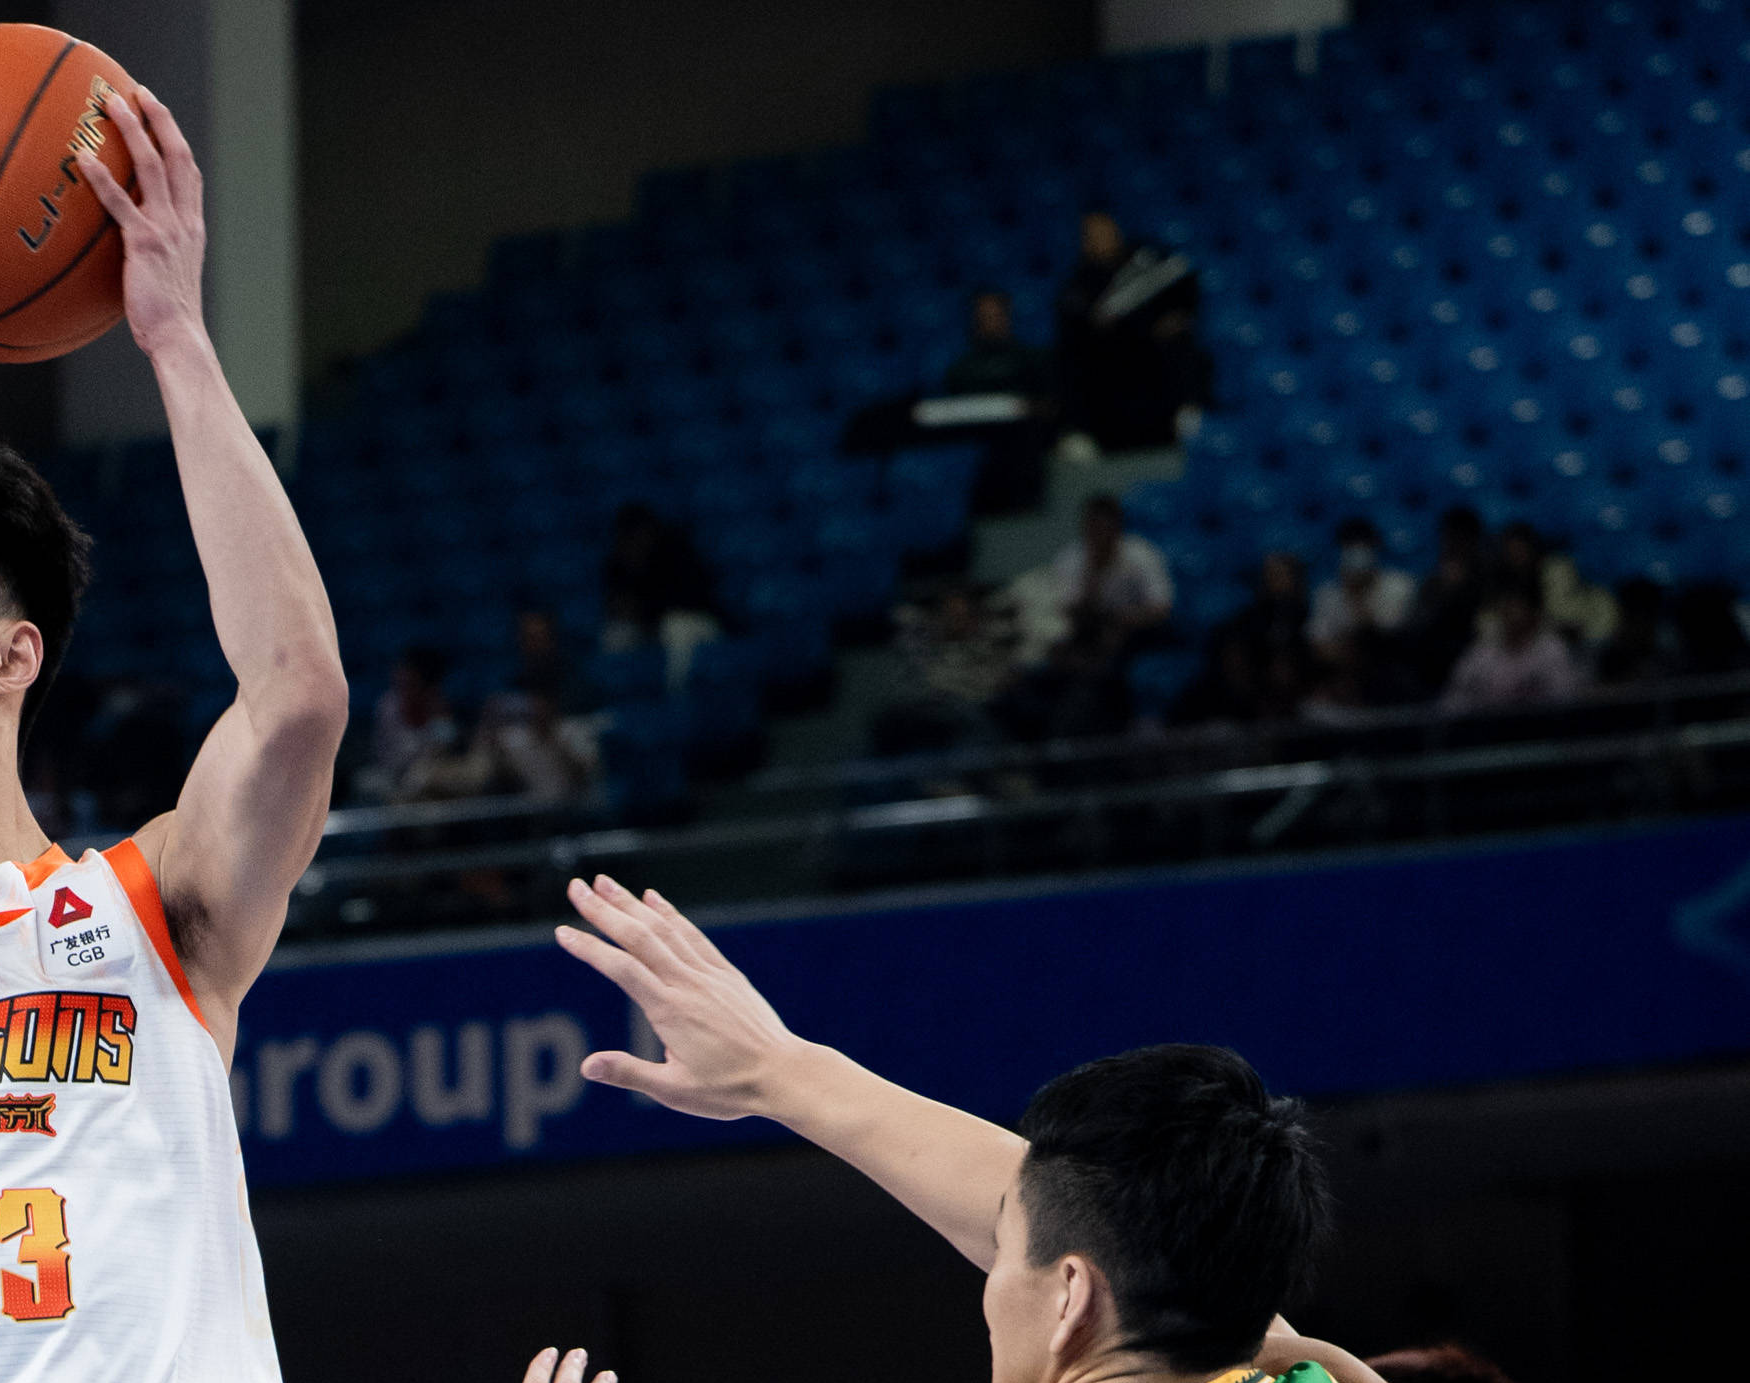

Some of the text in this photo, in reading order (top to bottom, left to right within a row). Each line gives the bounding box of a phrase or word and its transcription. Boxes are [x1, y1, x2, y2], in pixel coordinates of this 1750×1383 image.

[50, 925, 111, 954] 广发银行
[67, 946, 105, 967] CGB
[231, 1010, 589, 1150] roup
